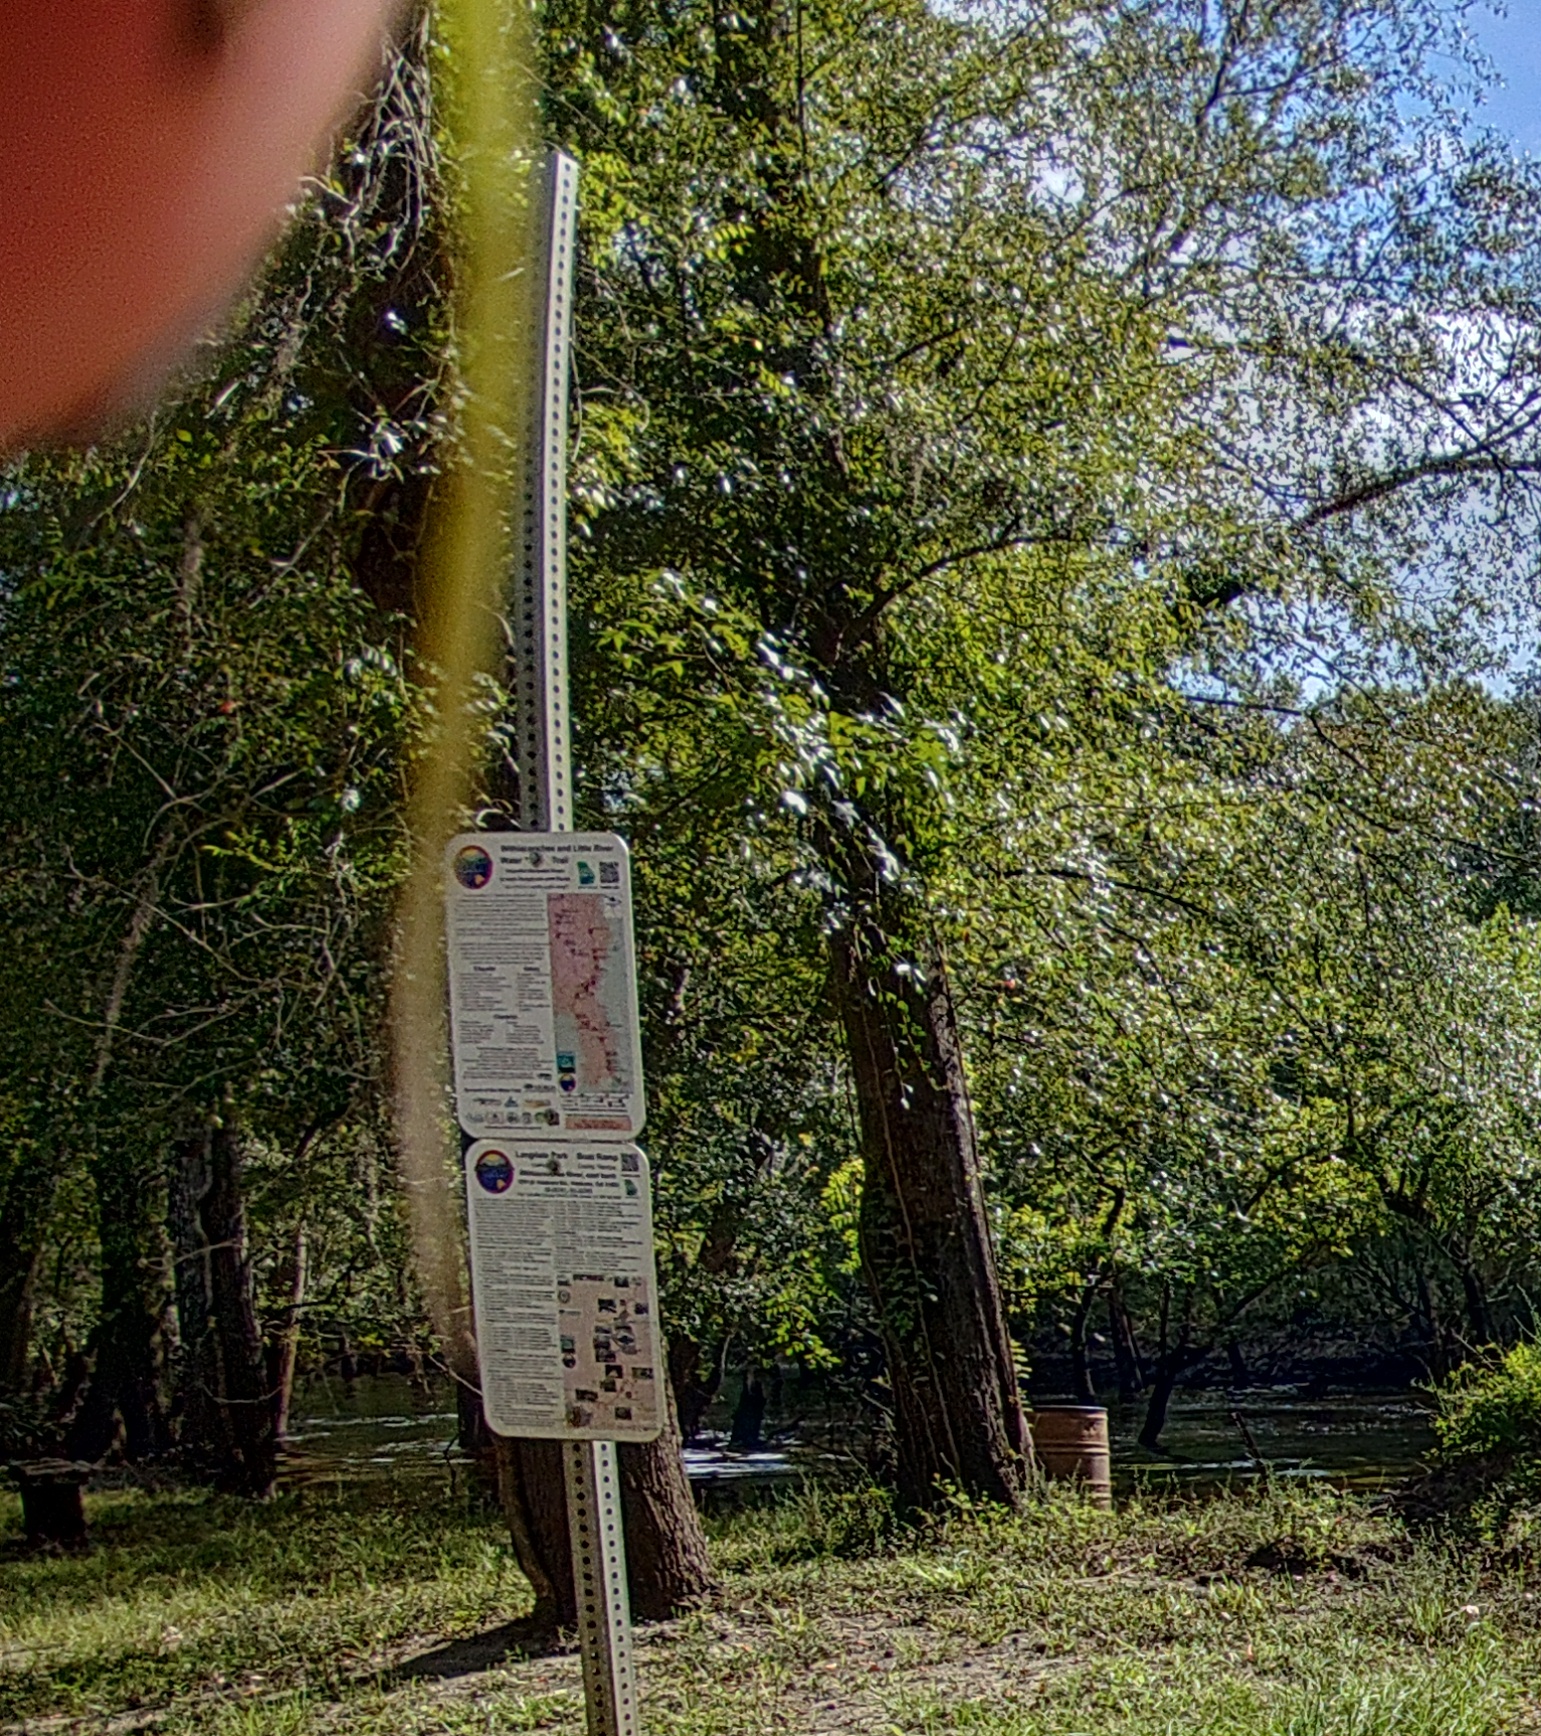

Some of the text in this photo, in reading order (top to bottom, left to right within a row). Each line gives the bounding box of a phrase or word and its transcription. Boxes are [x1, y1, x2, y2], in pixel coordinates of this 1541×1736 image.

[573, 844, 592, 852] Little
[593, 844, 614, 852] River
[551, 1151, 568, 1159] Park
[577, 1152, 595, 1160] Boat
[597, 1153, 618, 1162] Ramp
